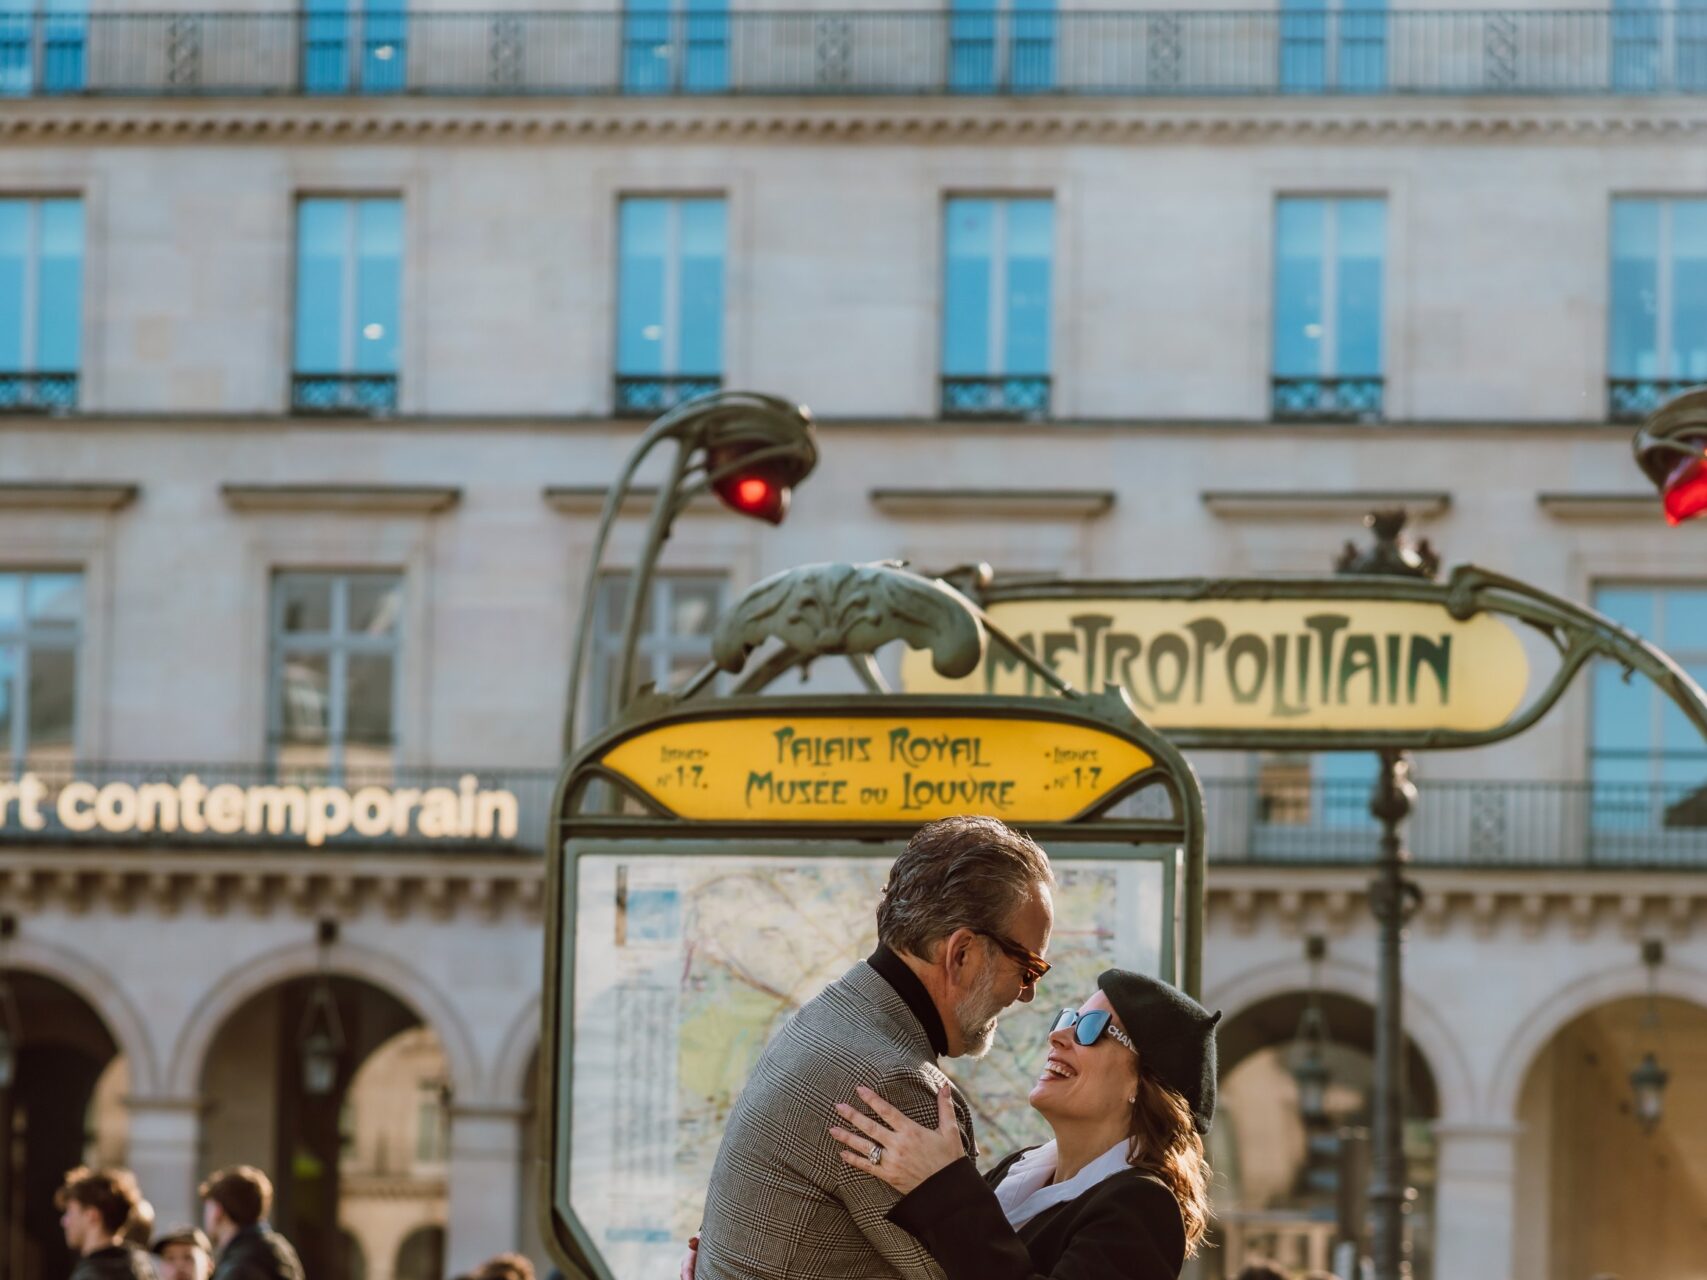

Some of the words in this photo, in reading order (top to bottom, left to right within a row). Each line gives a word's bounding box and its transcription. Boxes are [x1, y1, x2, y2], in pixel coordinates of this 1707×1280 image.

[985, 613, 1453, 717] METROPOLITAIN
[773, 726, 872, 767] PALAIS
[888, 726, 992, 769] ROYAL
[57, 773, 518, 847] contemporain
[900, 771, 1016, 811] LOUVRE
